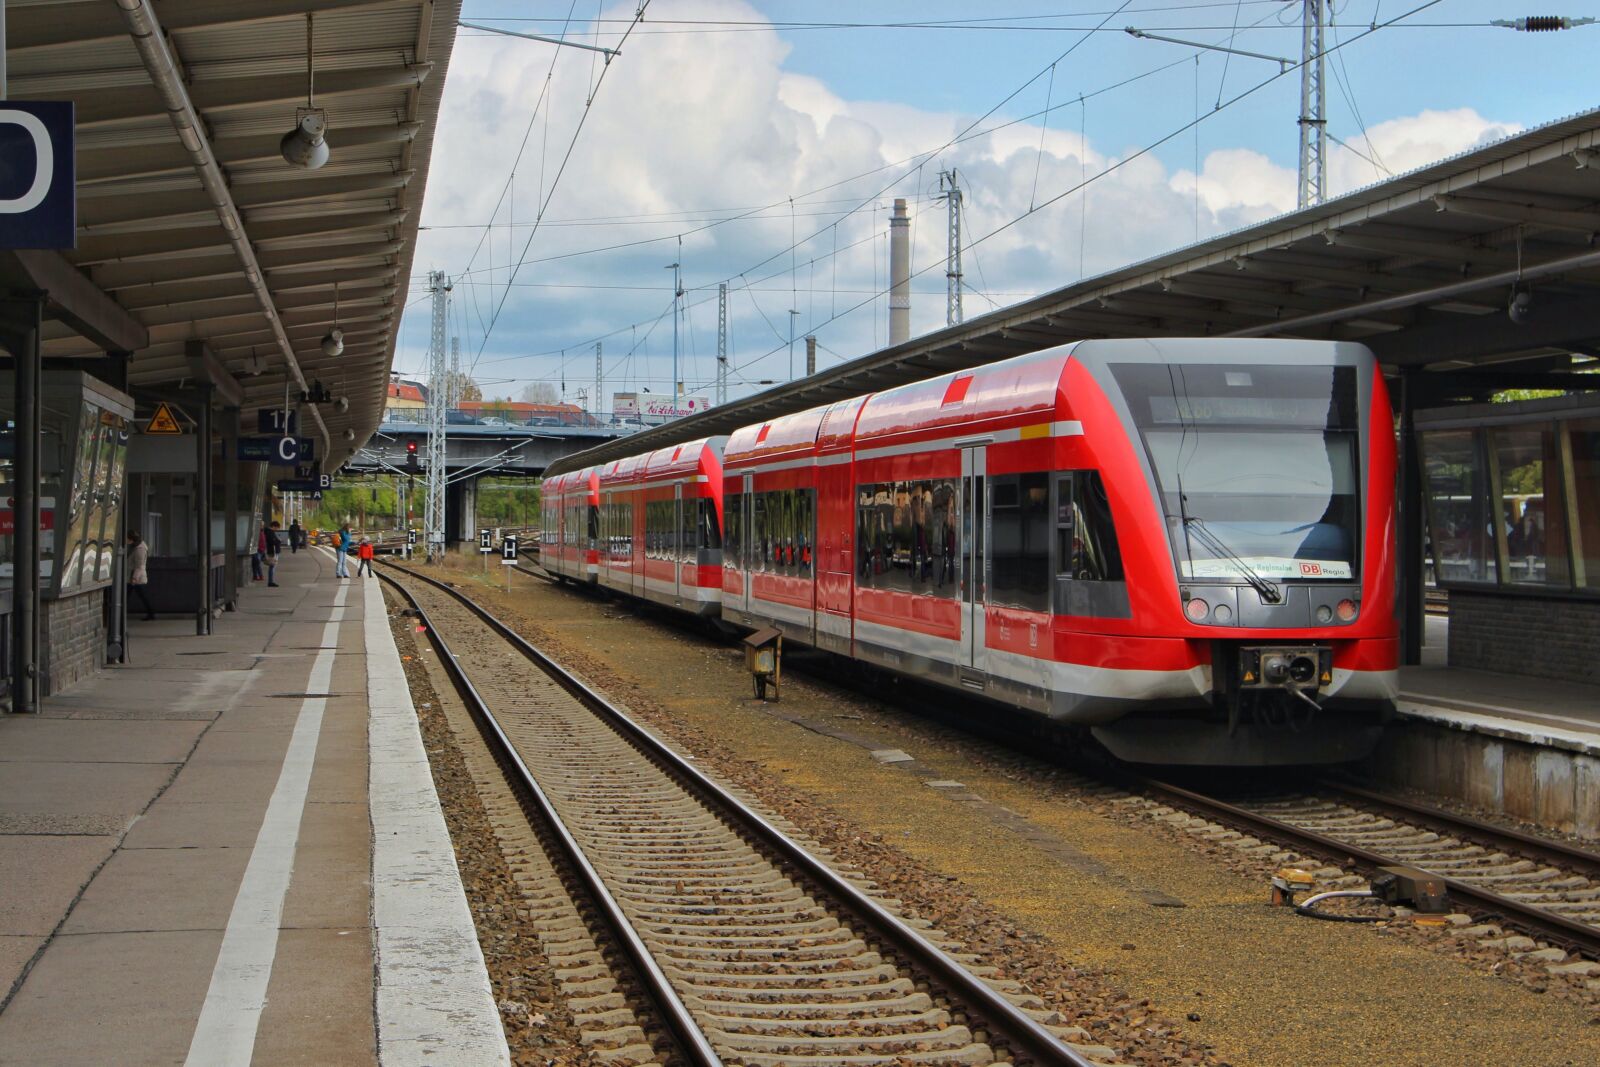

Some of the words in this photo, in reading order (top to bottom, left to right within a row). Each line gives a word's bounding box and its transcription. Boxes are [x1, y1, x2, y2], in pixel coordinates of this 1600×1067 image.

[270, 409, 292, 429] 17
[279, 437, 297, 460] C
[300, 467, 311, 476] 17
[319, 474, 330, 487] B
[408, 533, 416, 543] H
[481, 534, 491, 547] H
[504, 542, 516, 558] H
[1302, 564, 1319, 574] DB
[1322, 568, 1345, 576] Regio
